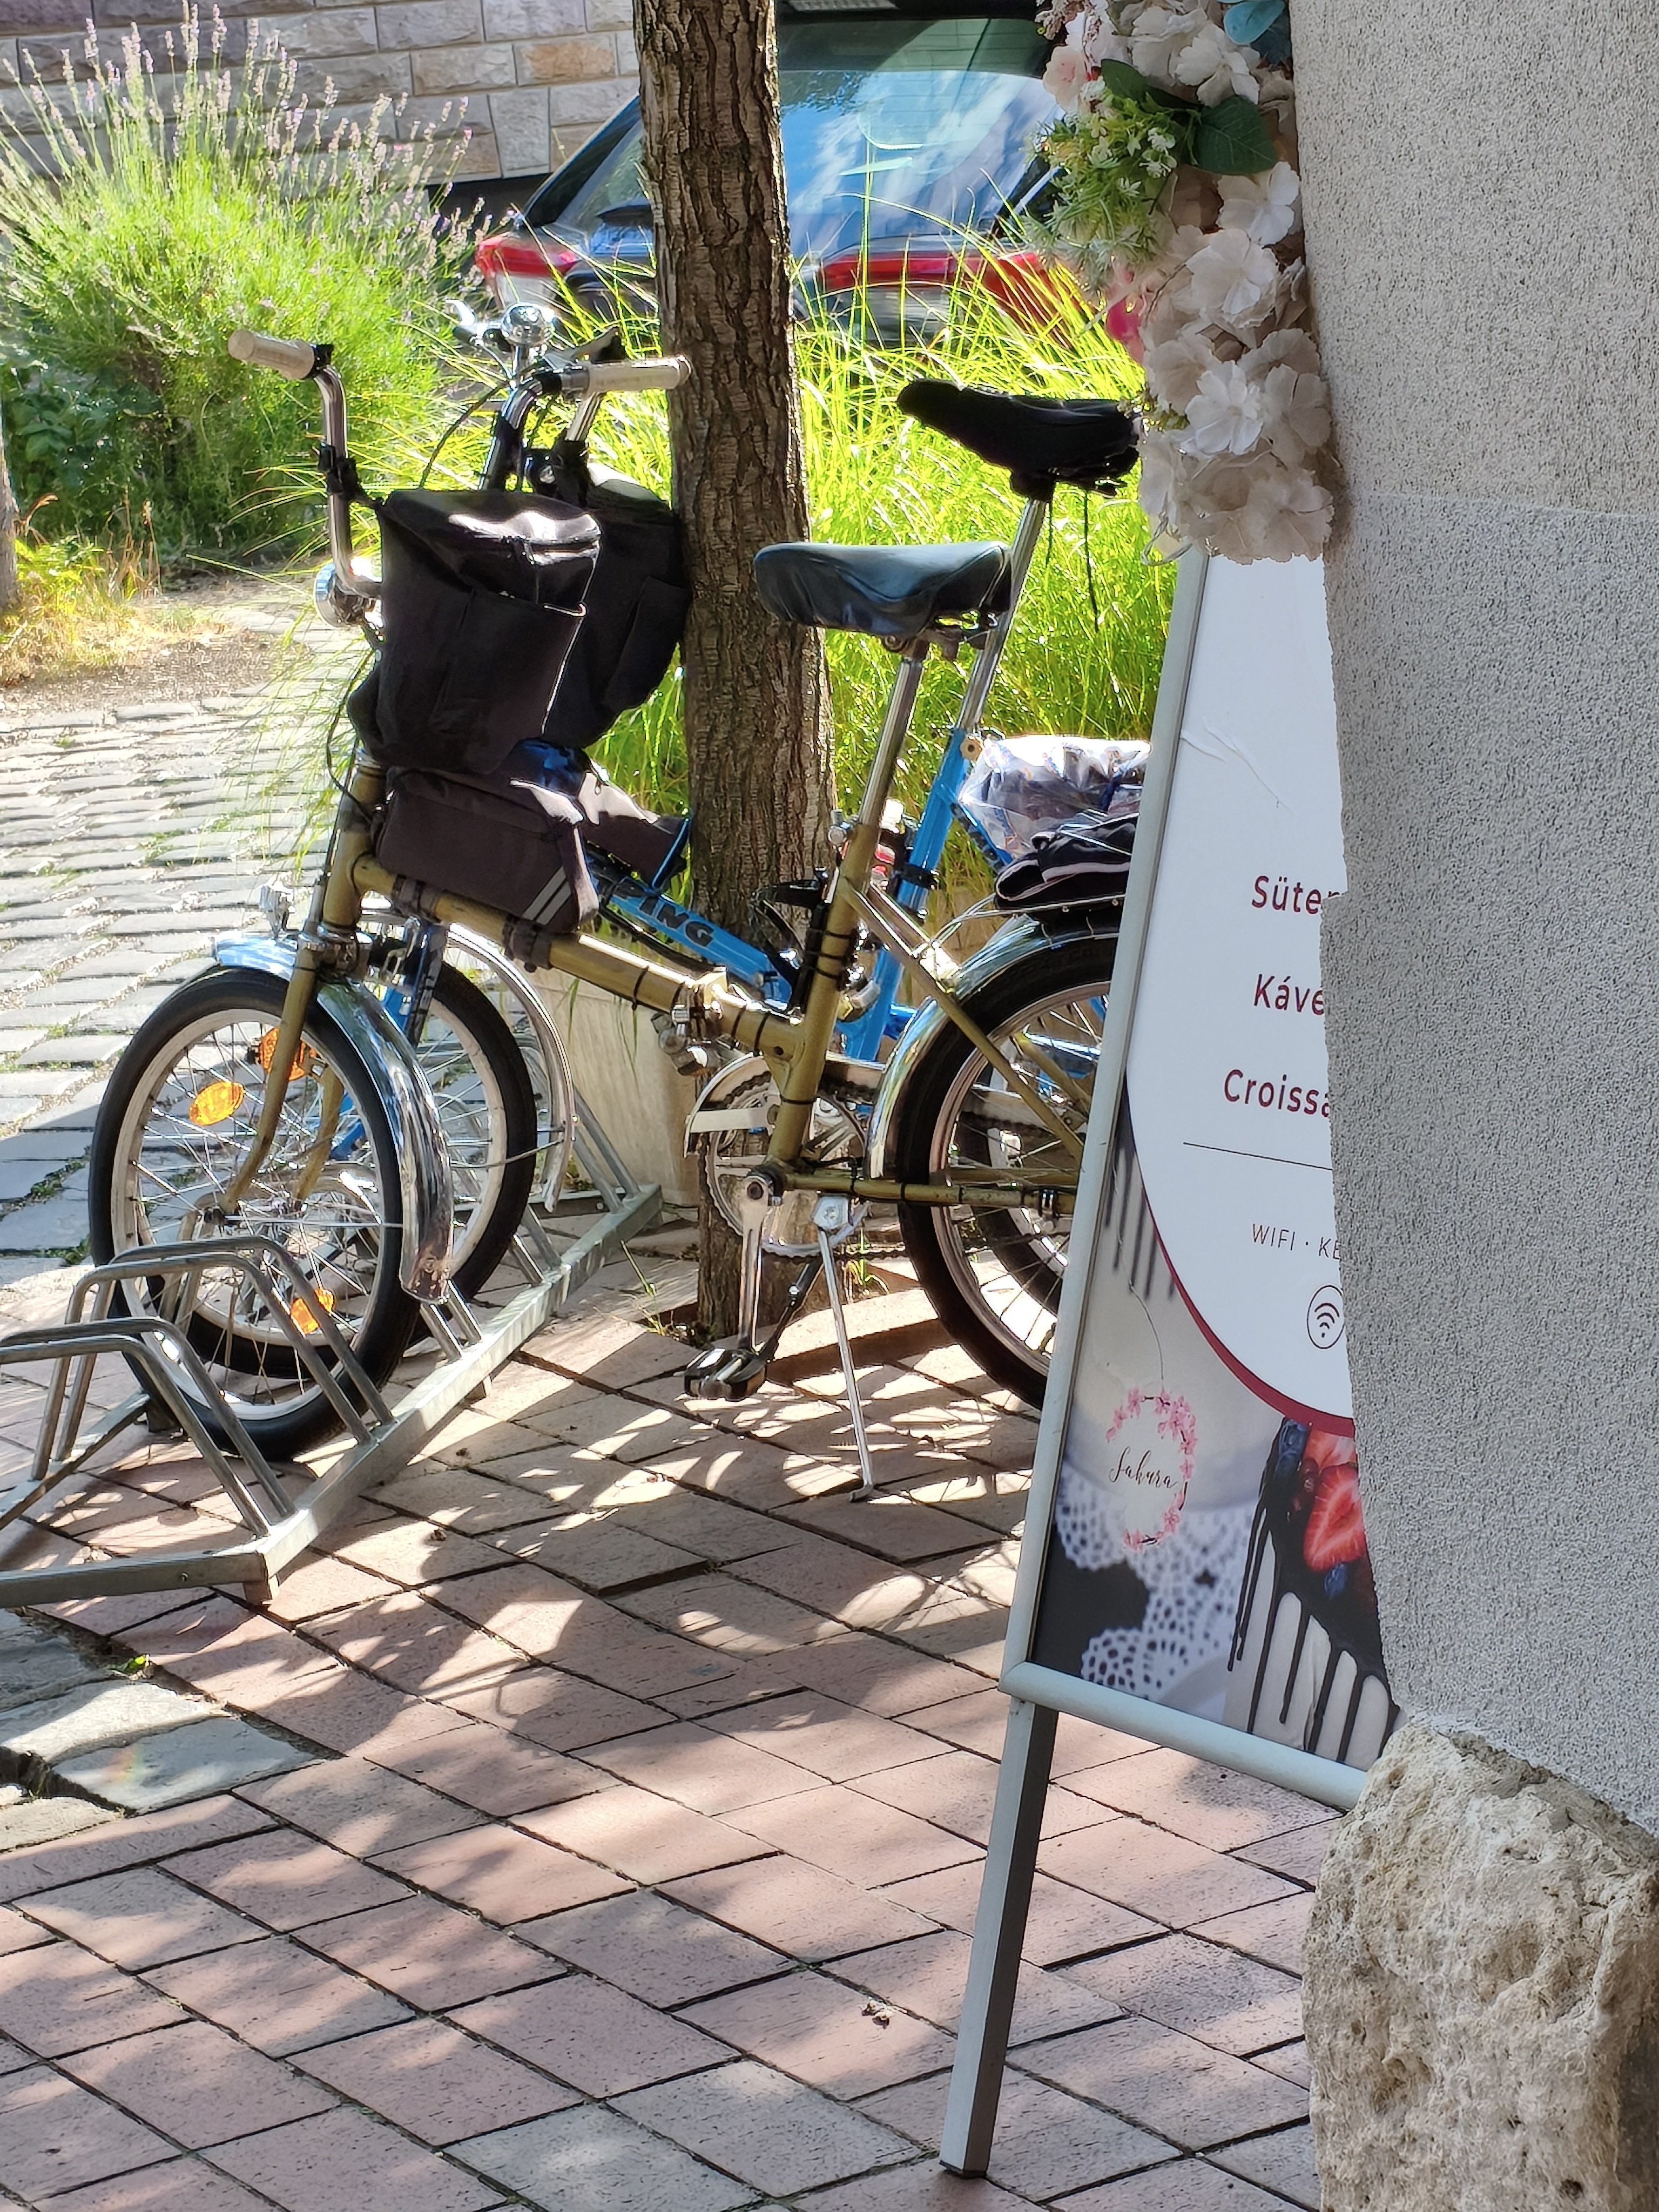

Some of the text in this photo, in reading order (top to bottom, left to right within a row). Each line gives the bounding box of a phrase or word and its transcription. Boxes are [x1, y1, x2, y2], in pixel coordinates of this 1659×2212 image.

[1251, 875, 1340, 914] Süte
[1252, 1223, 1296, 1251] WIFI
[1109, 1446, 1178, 1488] Sakura
